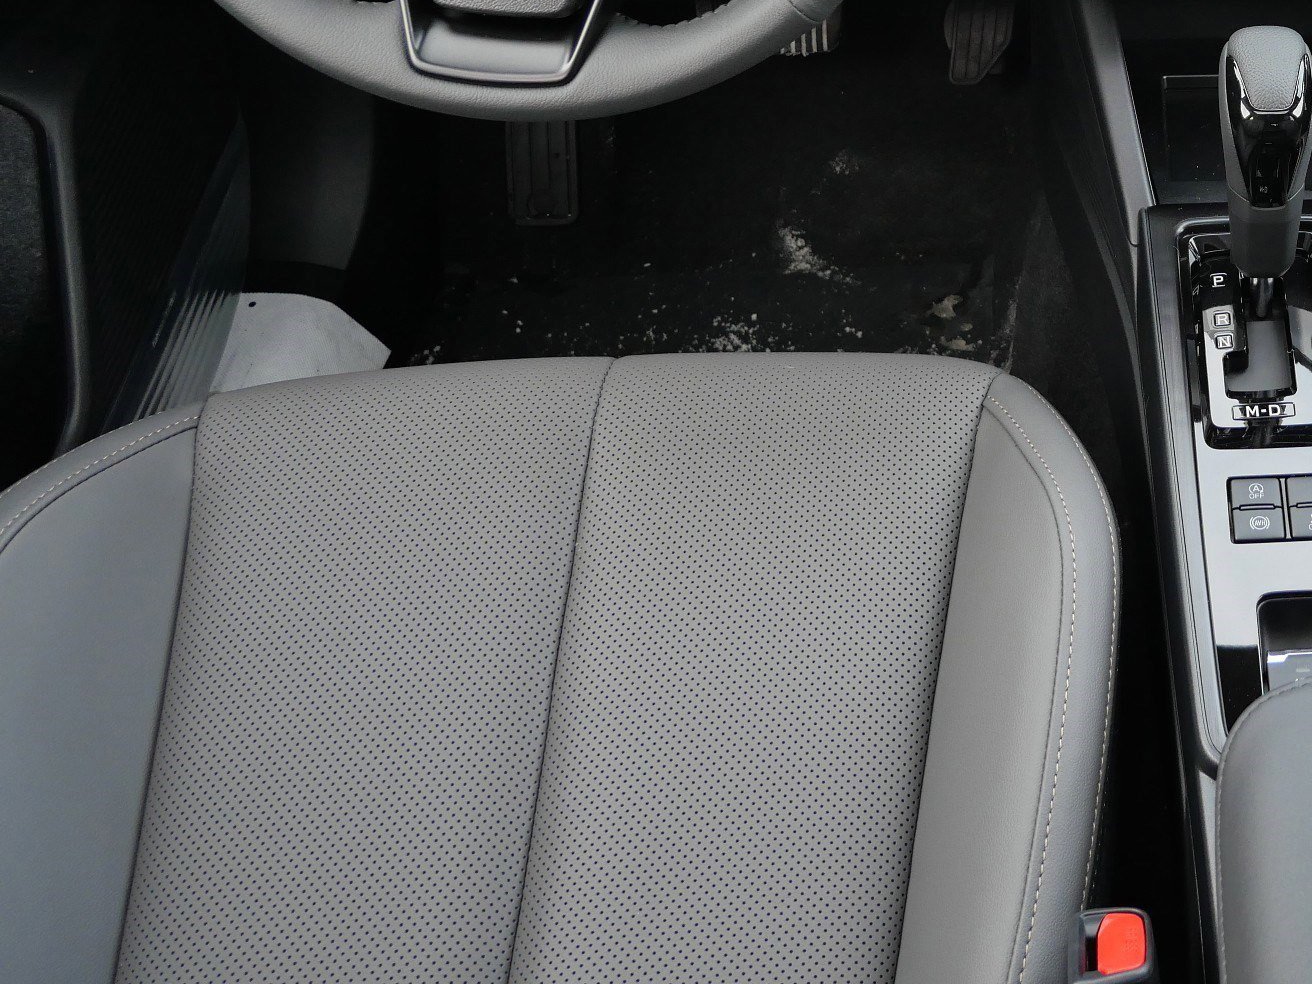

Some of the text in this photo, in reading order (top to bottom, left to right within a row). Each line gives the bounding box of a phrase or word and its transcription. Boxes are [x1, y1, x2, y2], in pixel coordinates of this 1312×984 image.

[1213, 276, 1224, 285] P
[1216, 314, 1228, 325] R
[1218, 336, 1231, 347] N
[1245, 404, 1281, 417] M-D
